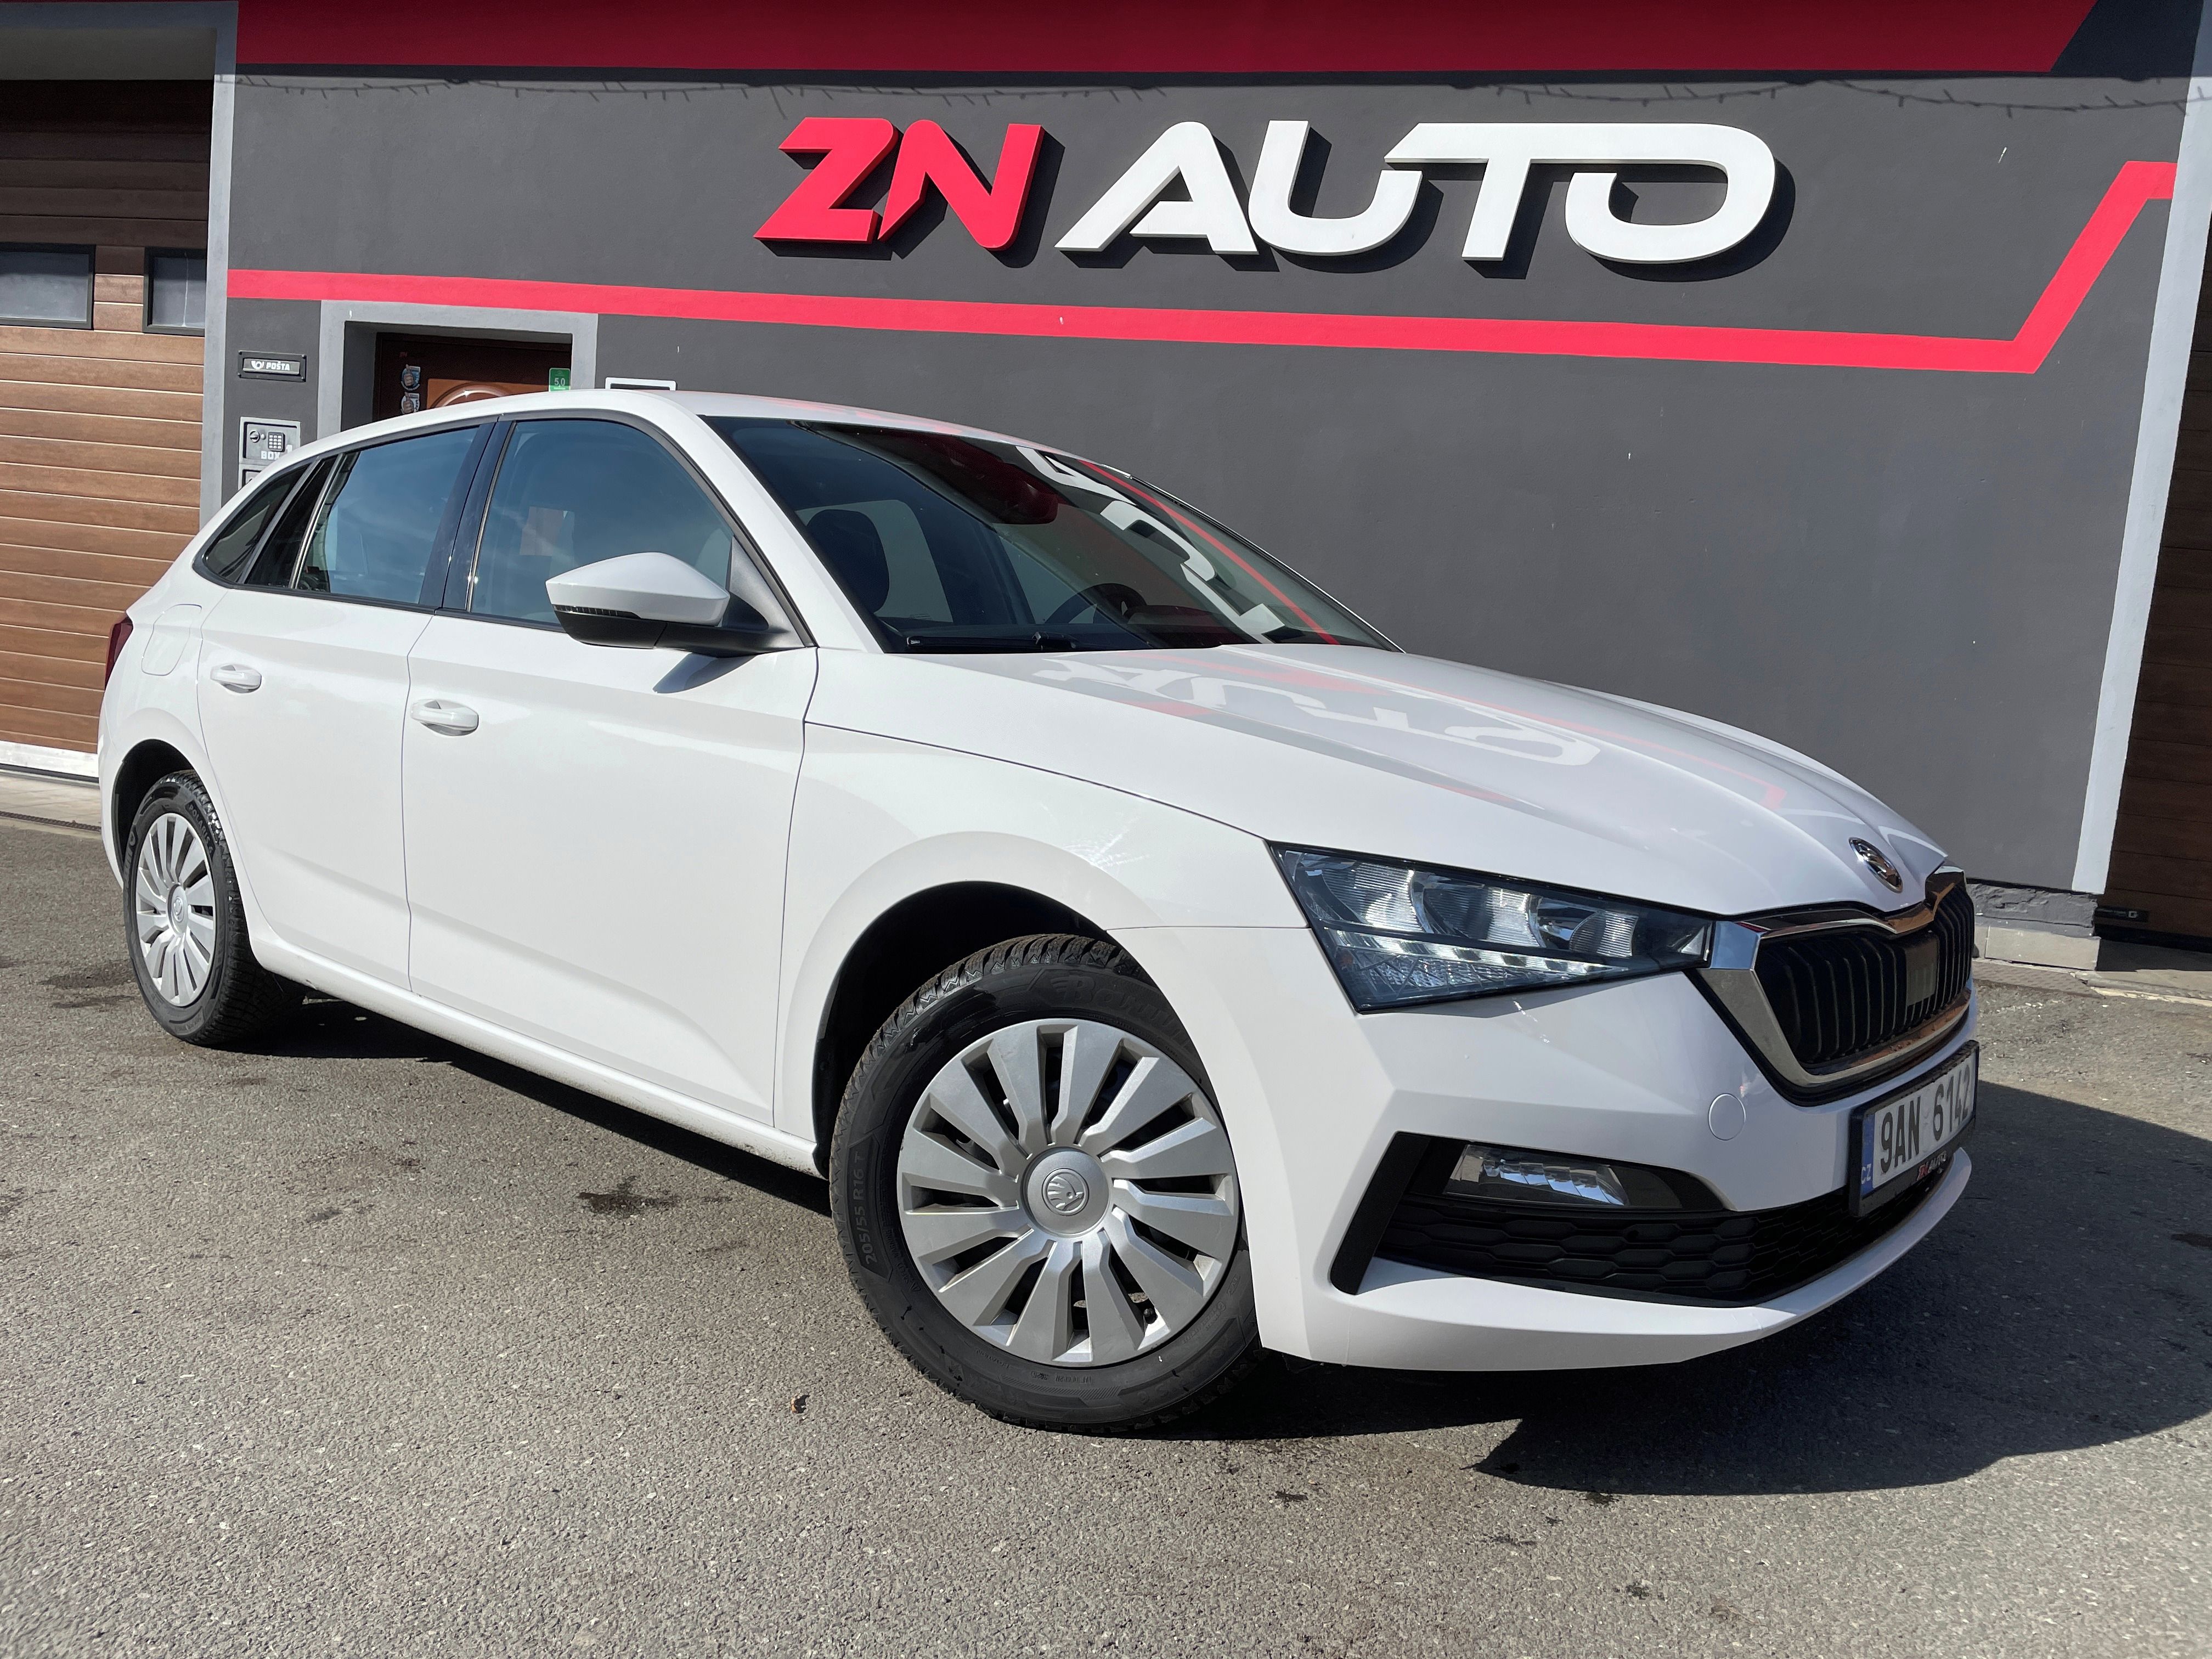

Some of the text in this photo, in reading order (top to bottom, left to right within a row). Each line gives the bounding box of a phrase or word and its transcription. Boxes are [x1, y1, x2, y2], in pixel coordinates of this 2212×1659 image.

[753, 117, 1775, 264] ZN AUTO
[266, 361, 290, 370] POŠTA
[261, 450, 280, 460] BOX
[189, 804, 210, 844] POLARIS
[1880, 1064, 1970, 1173] 9AN 6142
[853, 1168, 865, 1200] R16
[1861, 1163, 1872, 1184] CZ
[854, 1206, 877, 1265] 205/55
